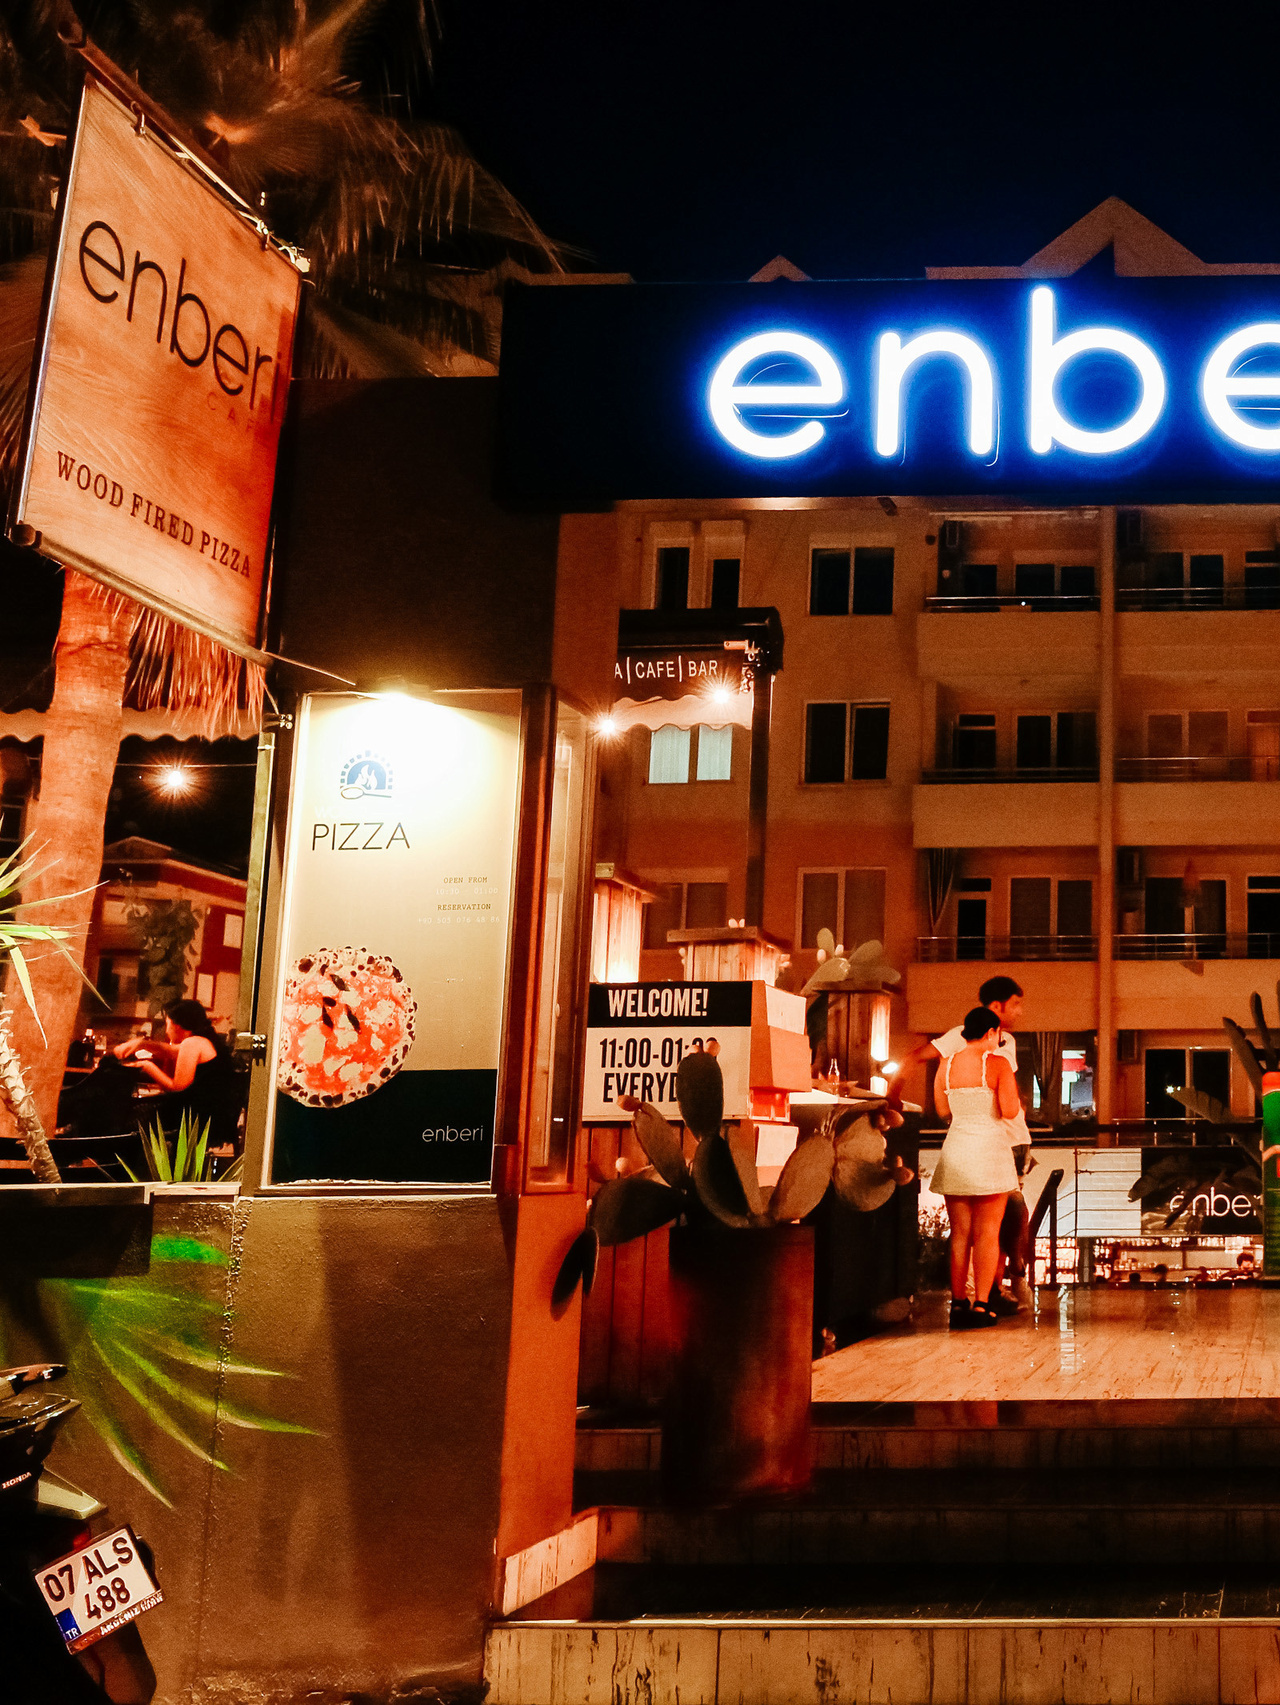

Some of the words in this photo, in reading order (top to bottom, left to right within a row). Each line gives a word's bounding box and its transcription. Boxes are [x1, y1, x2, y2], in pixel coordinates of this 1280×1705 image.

[58, 451, 124, 508] WOOD
[130, 492, 194, 546] FIRED
[199, 530, 251, 578] PIZZA
[635, 661, 676, 679] CAFE
[688, 660, 718, 677] BAR
[312, 821, 411, 851] PIZZA
[468, 876, 488, 884] FROM
[437, 903, 492, 911] RESERVATION
[608, 988, 709, 1017] WELCOME!
[603, 1072, 680, 1103] EVERYD
[421, 1124, 484, 1143] enberi
[1169, 1186, 1262, 1217] enber
[2, 1471, 32, 1489] HONDA
[43, 1563, 75, 1602] 07
[82, 1536, 133, 1584] ALS
[84, 1576, 131, 1620] 488
[66, 1628, 79, 1640] TR
